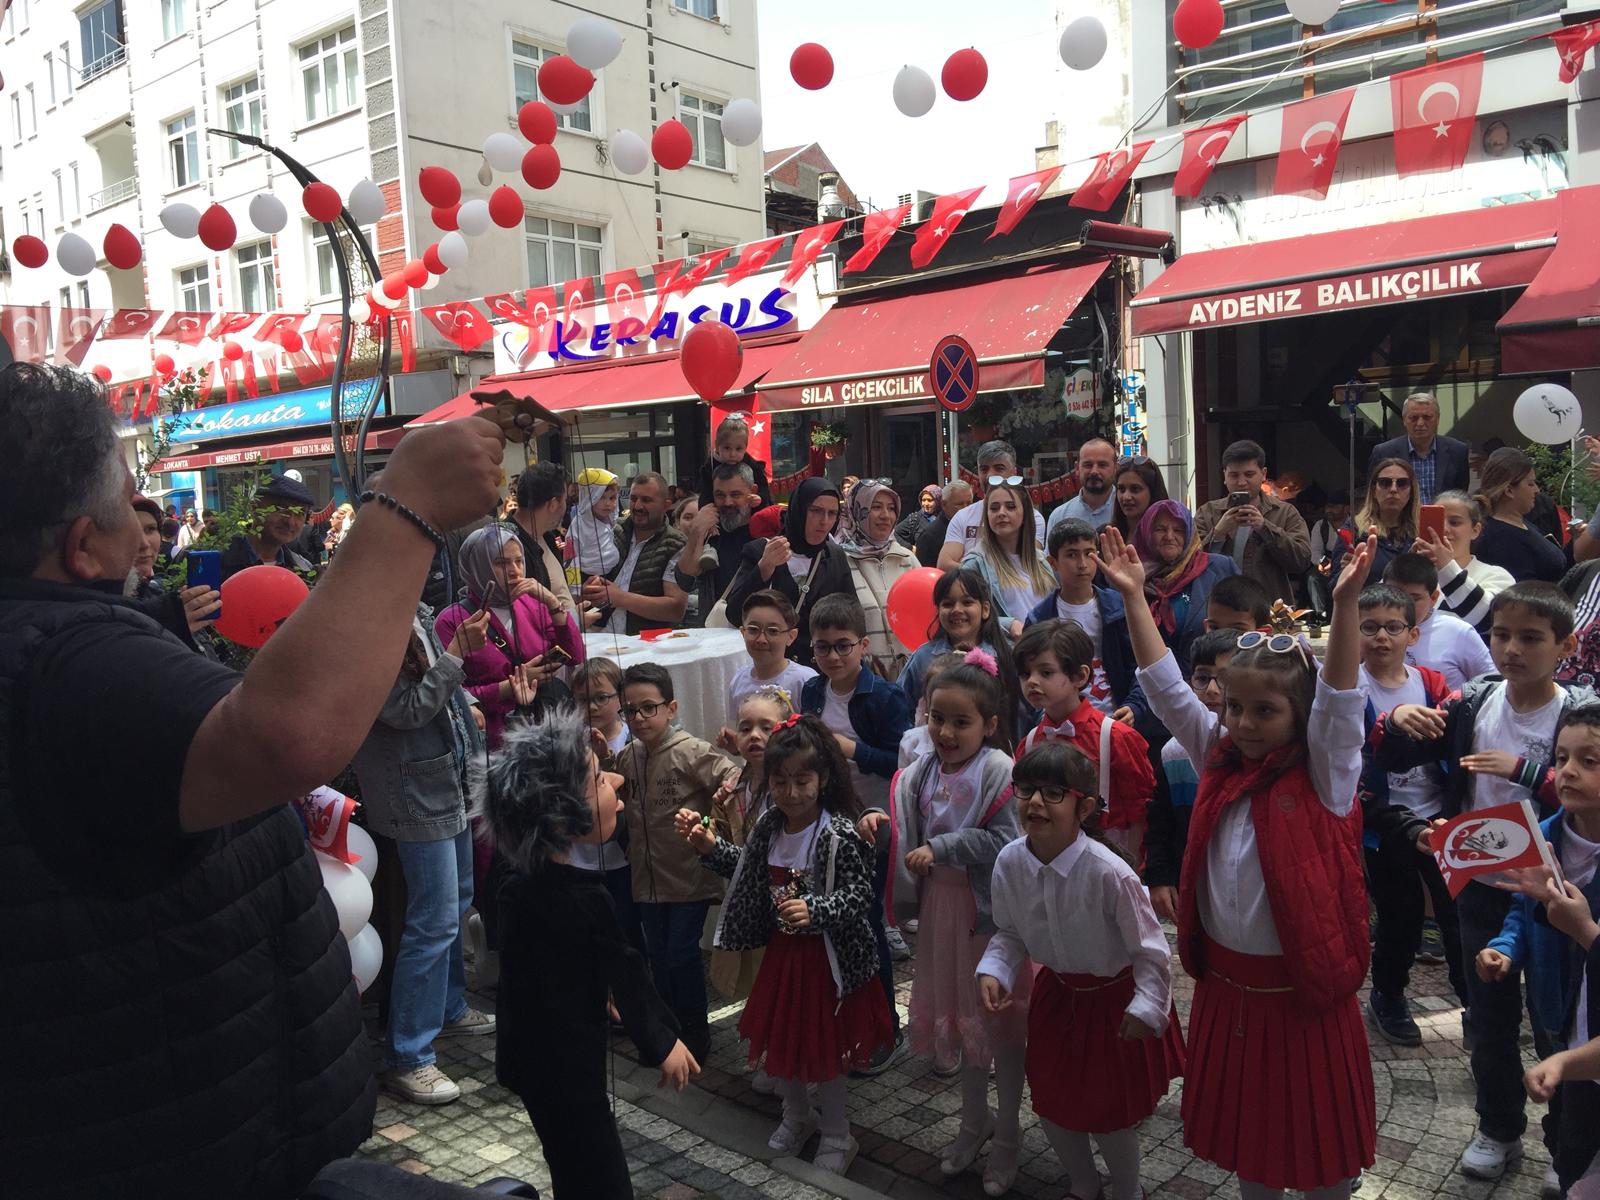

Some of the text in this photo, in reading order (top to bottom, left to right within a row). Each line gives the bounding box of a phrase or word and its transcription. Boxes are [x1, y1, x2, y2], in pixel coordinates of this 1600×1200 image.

[1317, 261, 1482, 307] BALIKÇILIK
[801, 385, 834, 404] SILA
[179, 402, 306, 435] Lokanta
[163, 450, 262, 470] LOKANTA MEHMET USTA
[656, 776, 681, 786] WHERE
